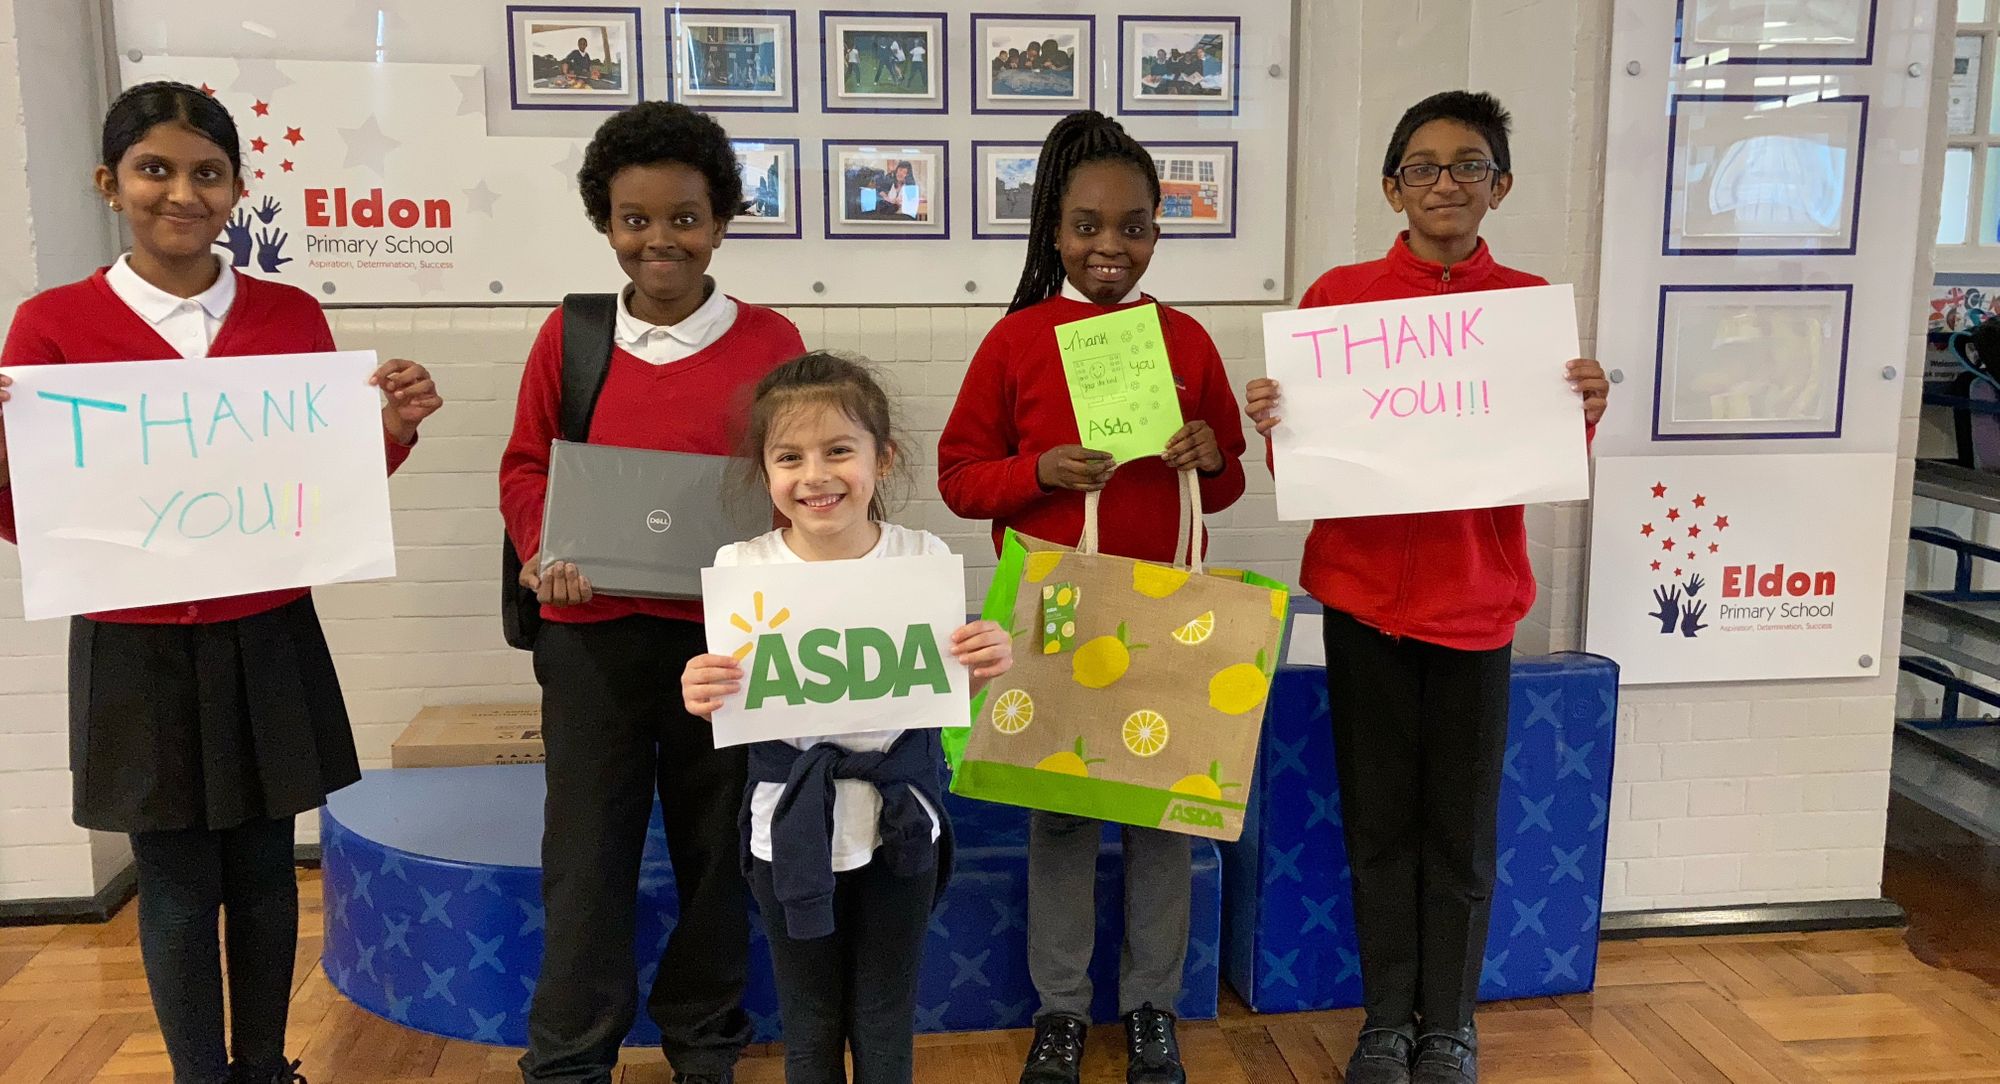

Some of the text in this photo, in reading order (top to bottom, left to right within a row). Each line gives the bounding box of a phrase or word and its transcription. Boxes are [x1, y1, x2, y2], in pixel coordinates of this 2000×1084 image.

[304, 187, 452, 229] Eldon
[306, 233, 453, 257] Primary School
[308, 259, 454, 271] Aspiration, Determination, Success
[1063, 329, 1109, 352] Thank
[1292, 307, 1485, 379] THANK
[1129, 359, 1155, 377] you
[1362, 379, 1490, 420] YOU!!!
[37, 382, 329, 468] THANK
[649, 517, 669, 525] DELL
[1722, 563, 1836, 598] Eldon
[1719, 601, 1834, 621] Primary School
[744, 623, 952, 710] ASDA
[1168, 804, 1225, 829] ASDA
